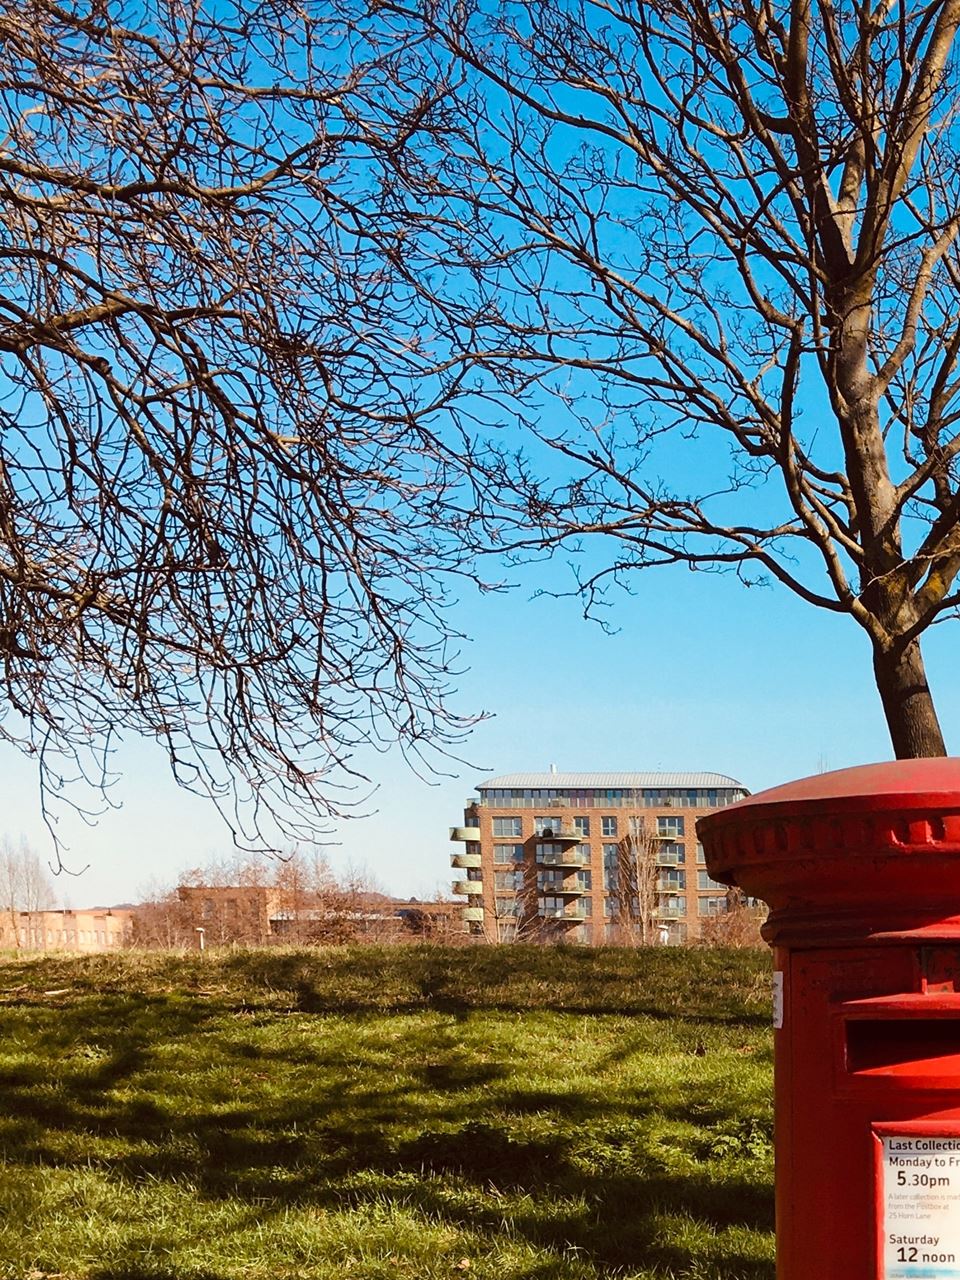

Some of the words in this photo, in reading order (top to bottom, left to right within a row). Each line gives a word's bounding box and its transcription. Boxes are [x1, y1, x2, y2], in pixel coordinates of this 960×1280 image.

[889, 1140, 912, 1150] Last
[889, 1157, 932, 1169] Monday
[935, 1158, 946, 1167] to
[897, 1171, 950, 1188] 5.30pm
[889, 1234, 940, 1246] Saturday
[897, 1247, 918, 1262] 12
[922, 1254, 955, 1262] noon
